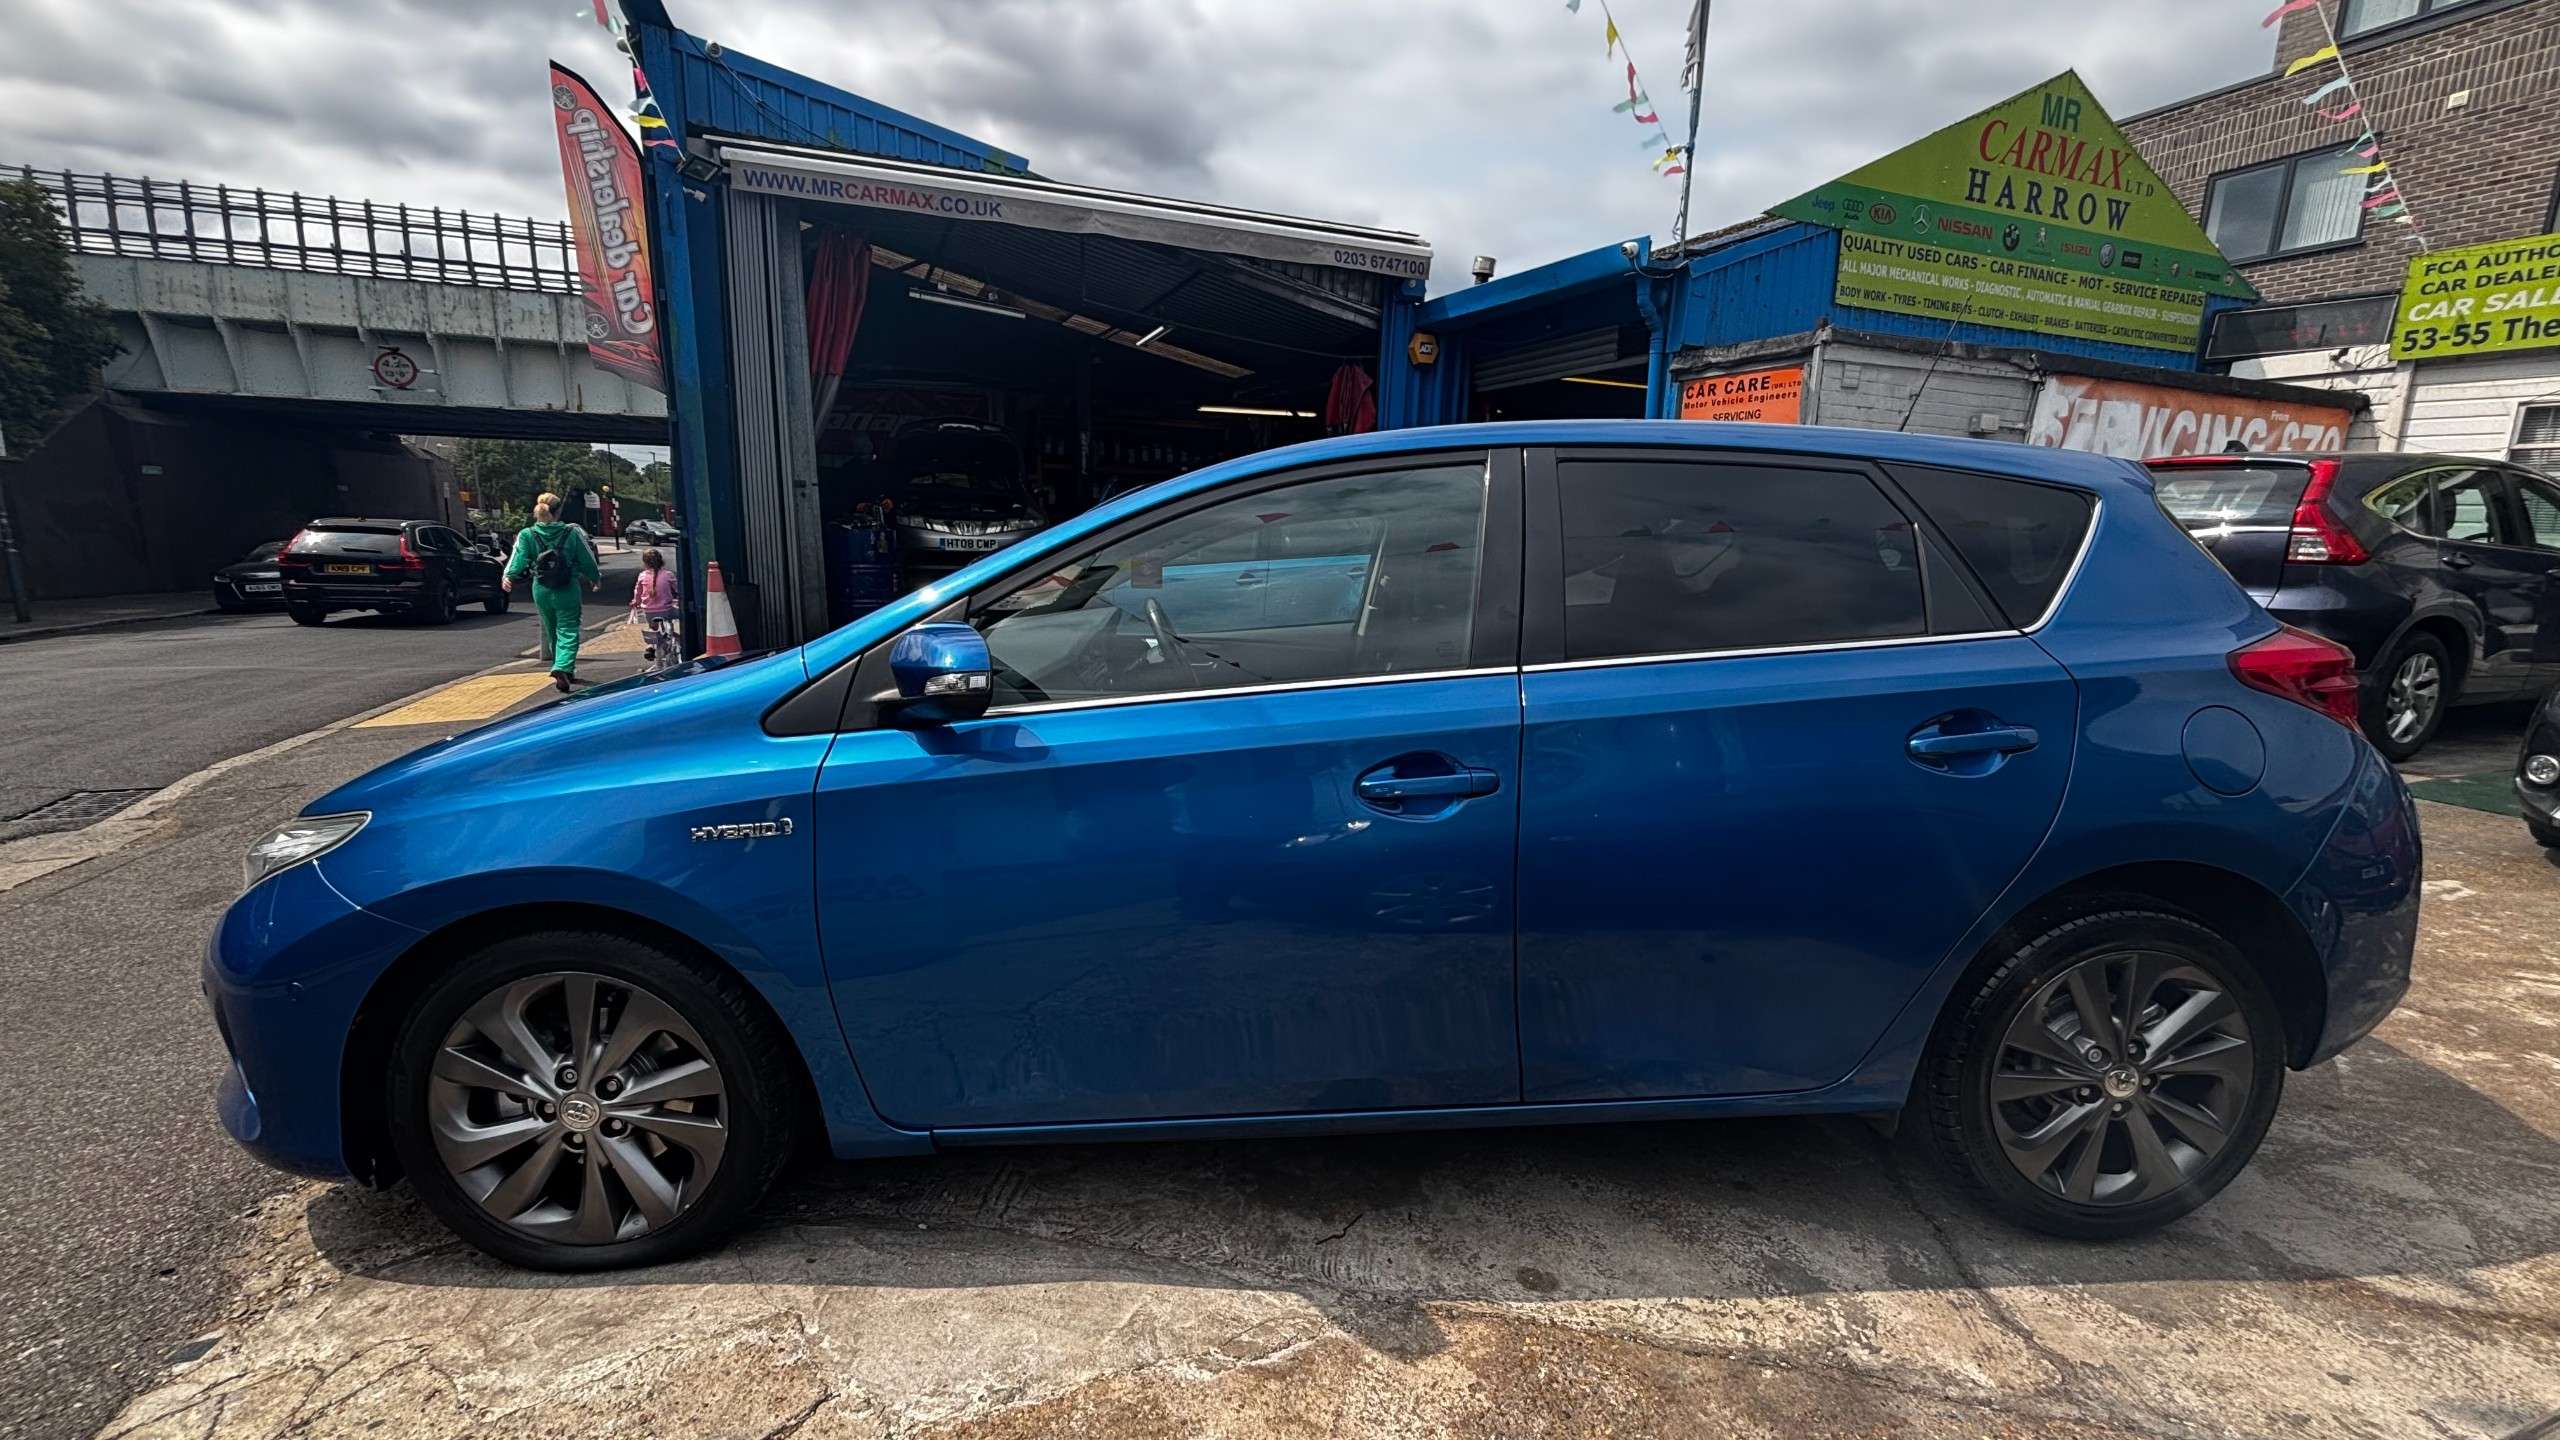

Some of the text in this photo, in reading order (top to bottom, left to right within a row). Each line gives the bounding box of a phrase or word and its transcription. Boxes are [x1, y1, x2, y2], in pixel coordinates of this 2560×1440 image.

[2041, 93, 2081, 133] MR
[1979, 119, 2154, 197] CARMAX LTD
[743, 169, 1002, 218] WWW.MRCARMAX.CO.UK
[1965, 167, 2131, 231] HARROW
[1938, 216, 1993, 240] NISSAN
[1334, 250, 1425, 275] 0203 6747100
[1842, 260, 1858, 273] ALL
[1860, 262, 1888, 277] MAJOR
[1889, 266, 1939, 287] MECHANICAL
[1942, 275, 1969, 290] WORKS
[1844, 235, 2204, 307] QUALITY USED CARS CAR FINANCE MOT SERVICE REPAIRS
[2424, 258, 2468, 277] FCA
[2420, 264, 2560, 296] CAR DEALE
[1840, 286, 1862, 298] BODY
[1864, 288, 1887, 302] WORK
[1893, 293, 1917, 306] TYRES
[1923, 298, 1950, 312] TIMING
[1978, 306, 2004, 319] CLUTCH
[2408, 297, 2475, 321] CAR
[2401, 321, 2492, 352] 53-55
[1684, 390, 1798, 410] Motor Vehicle Engineers
[1686, 383, 1717, 400] CAR
[1725, 376, 1771, 395] CARE
[1712, 409, 1762, 421] SERVICING
[947, 539, 975, 549] HT08
[690, 822, 778, 842] HYBRID
